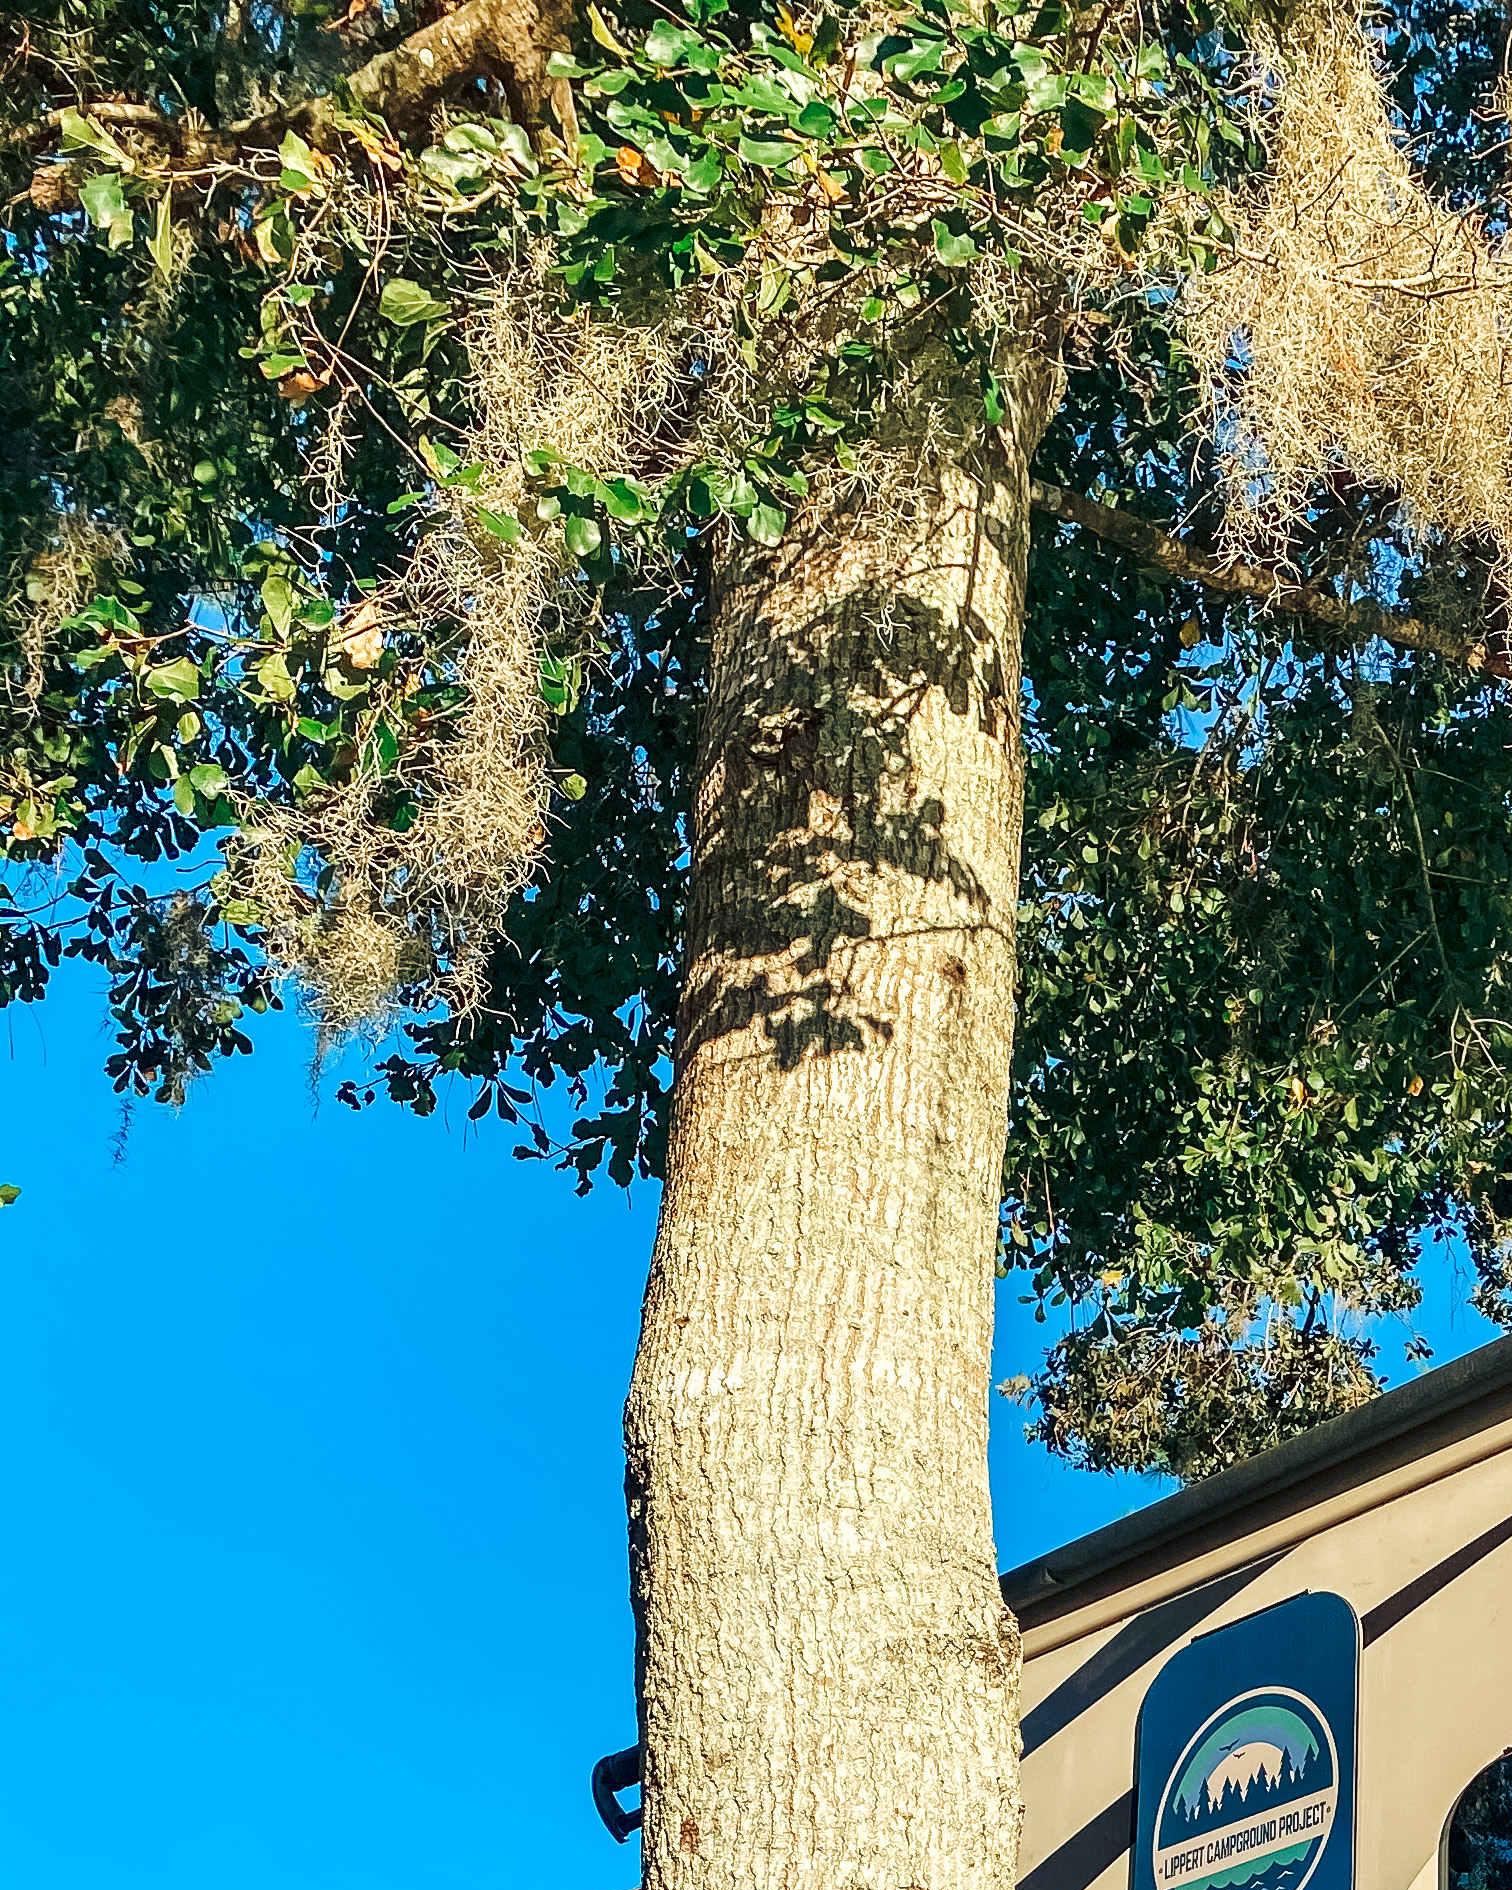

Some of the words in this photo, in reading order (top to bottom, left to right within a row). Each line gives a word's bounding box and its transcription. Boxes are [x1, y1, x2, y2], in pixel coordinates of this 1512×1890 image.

[1164, 1846, 1206, 1880] LIPPERT
[1206, 1820, 1276, 1864] CAMPGROUND
[1279, 1801, 1326, 1839] PROJECT
